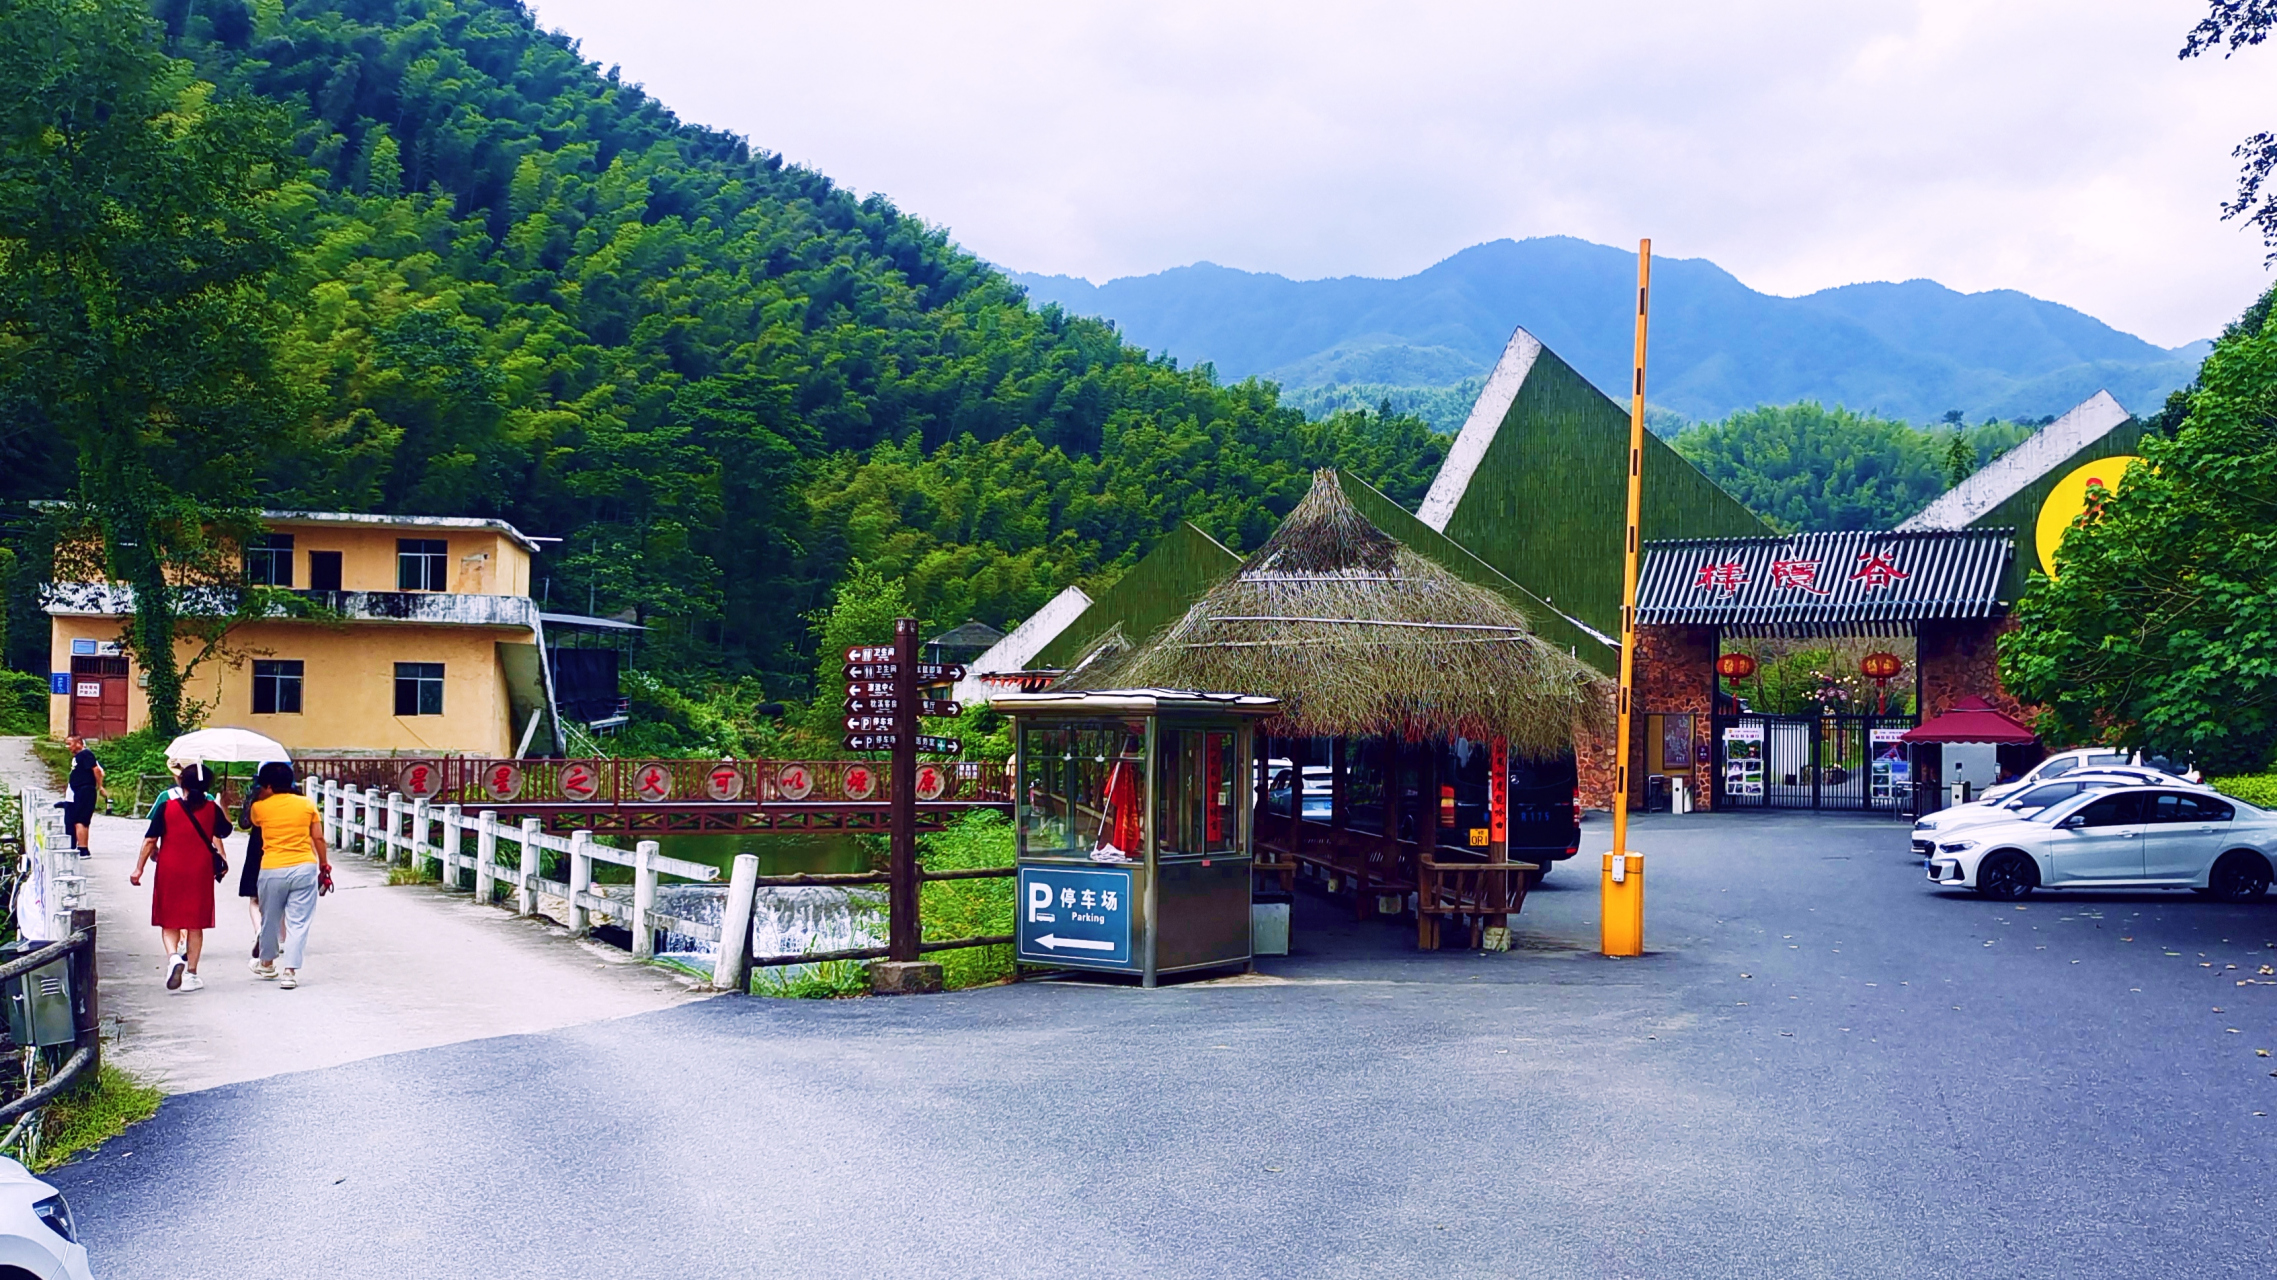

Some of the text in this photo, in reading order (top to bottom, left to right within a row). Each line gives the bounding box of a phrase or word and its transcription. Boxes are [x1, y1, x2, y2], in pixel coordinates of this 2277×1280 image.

[873, 717, 894, 726] 停车场
[876, 736, 897, 745] 停车场
[1028, 882, 1054, 922] P
[1060, 887, 1118, 911] 停车场
[1071, 912, 1105, 924] Parking
